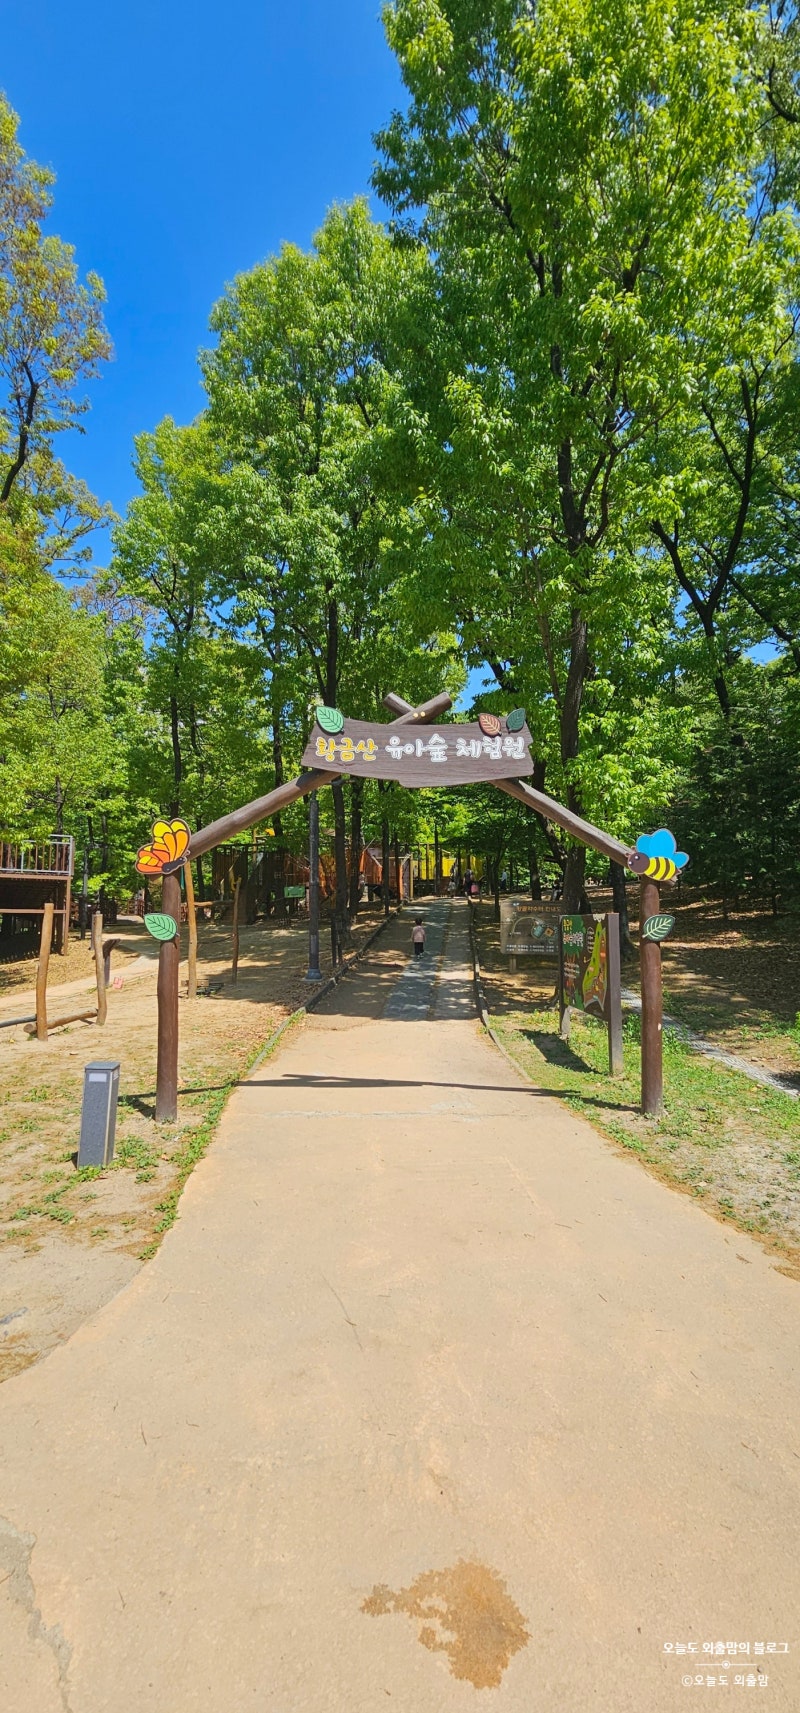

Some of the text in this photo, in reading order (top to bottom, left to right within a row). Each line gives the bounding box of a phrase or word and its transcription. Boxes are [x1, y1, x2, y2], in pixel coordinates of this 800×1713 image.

[316, 733, 526, 762] 황금산 유아숲 체험원
